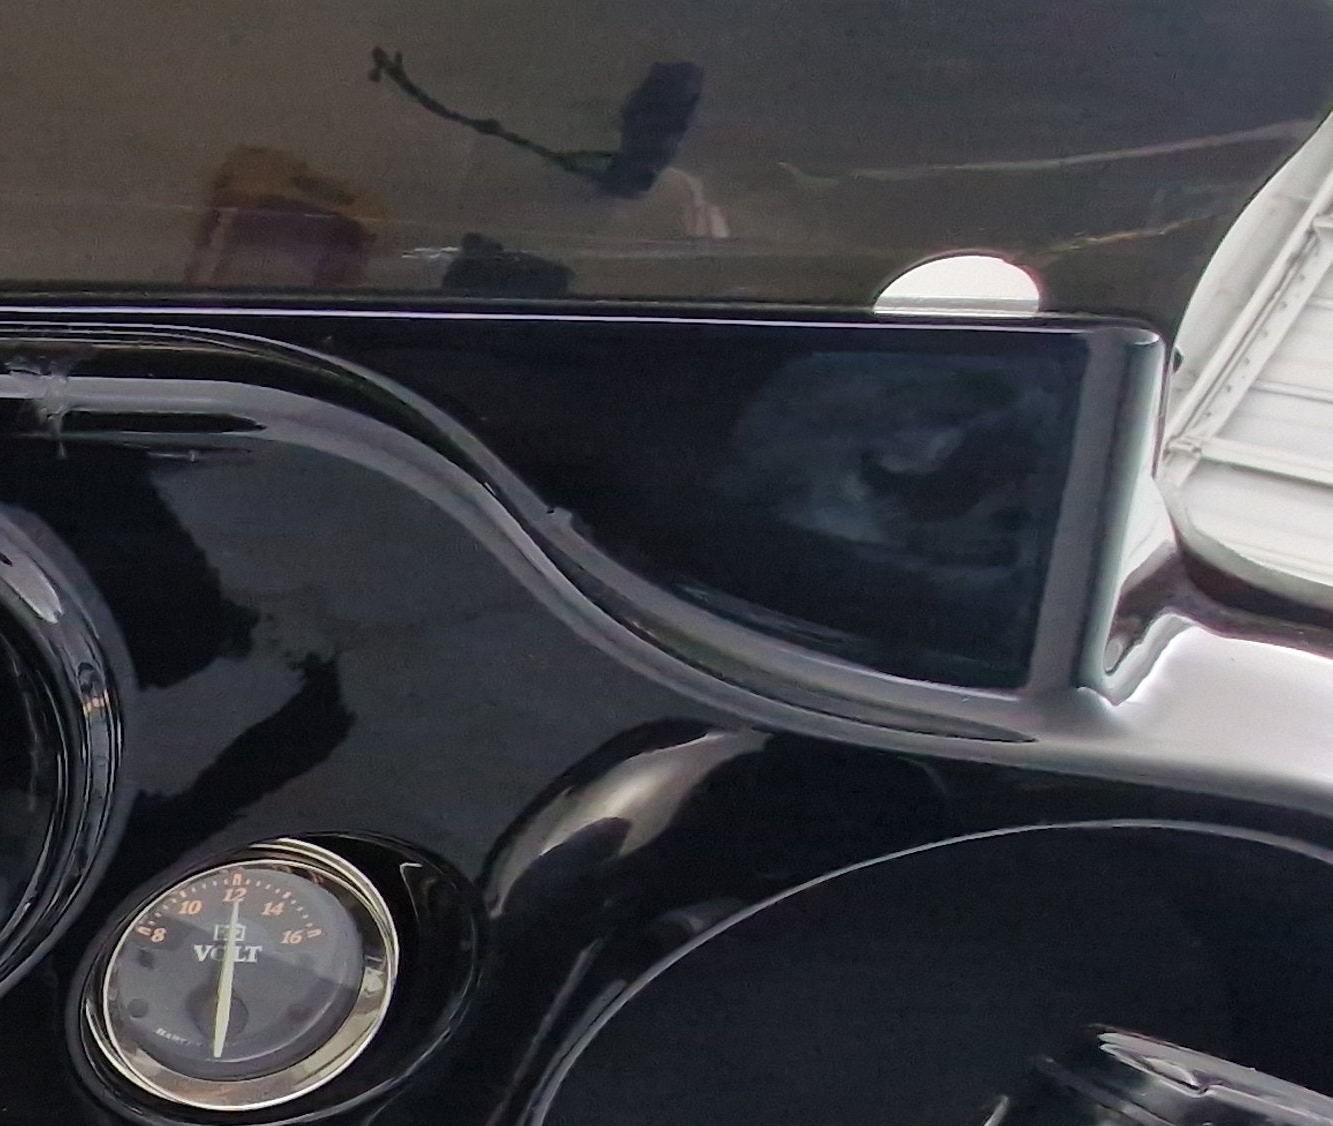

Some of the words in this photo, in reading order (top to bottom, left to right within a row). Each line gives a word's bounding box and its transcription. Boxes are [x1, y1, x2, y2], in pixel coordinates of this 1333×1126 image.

[222, 887, 247, 903] 12
[178, 900, 202, 915] 10
[260, 901, 284, 916] 14
[151, 927, 166, 942] 8
[280, 929, 302, 945] 16
[193, 944, 263, 963] VOLT
